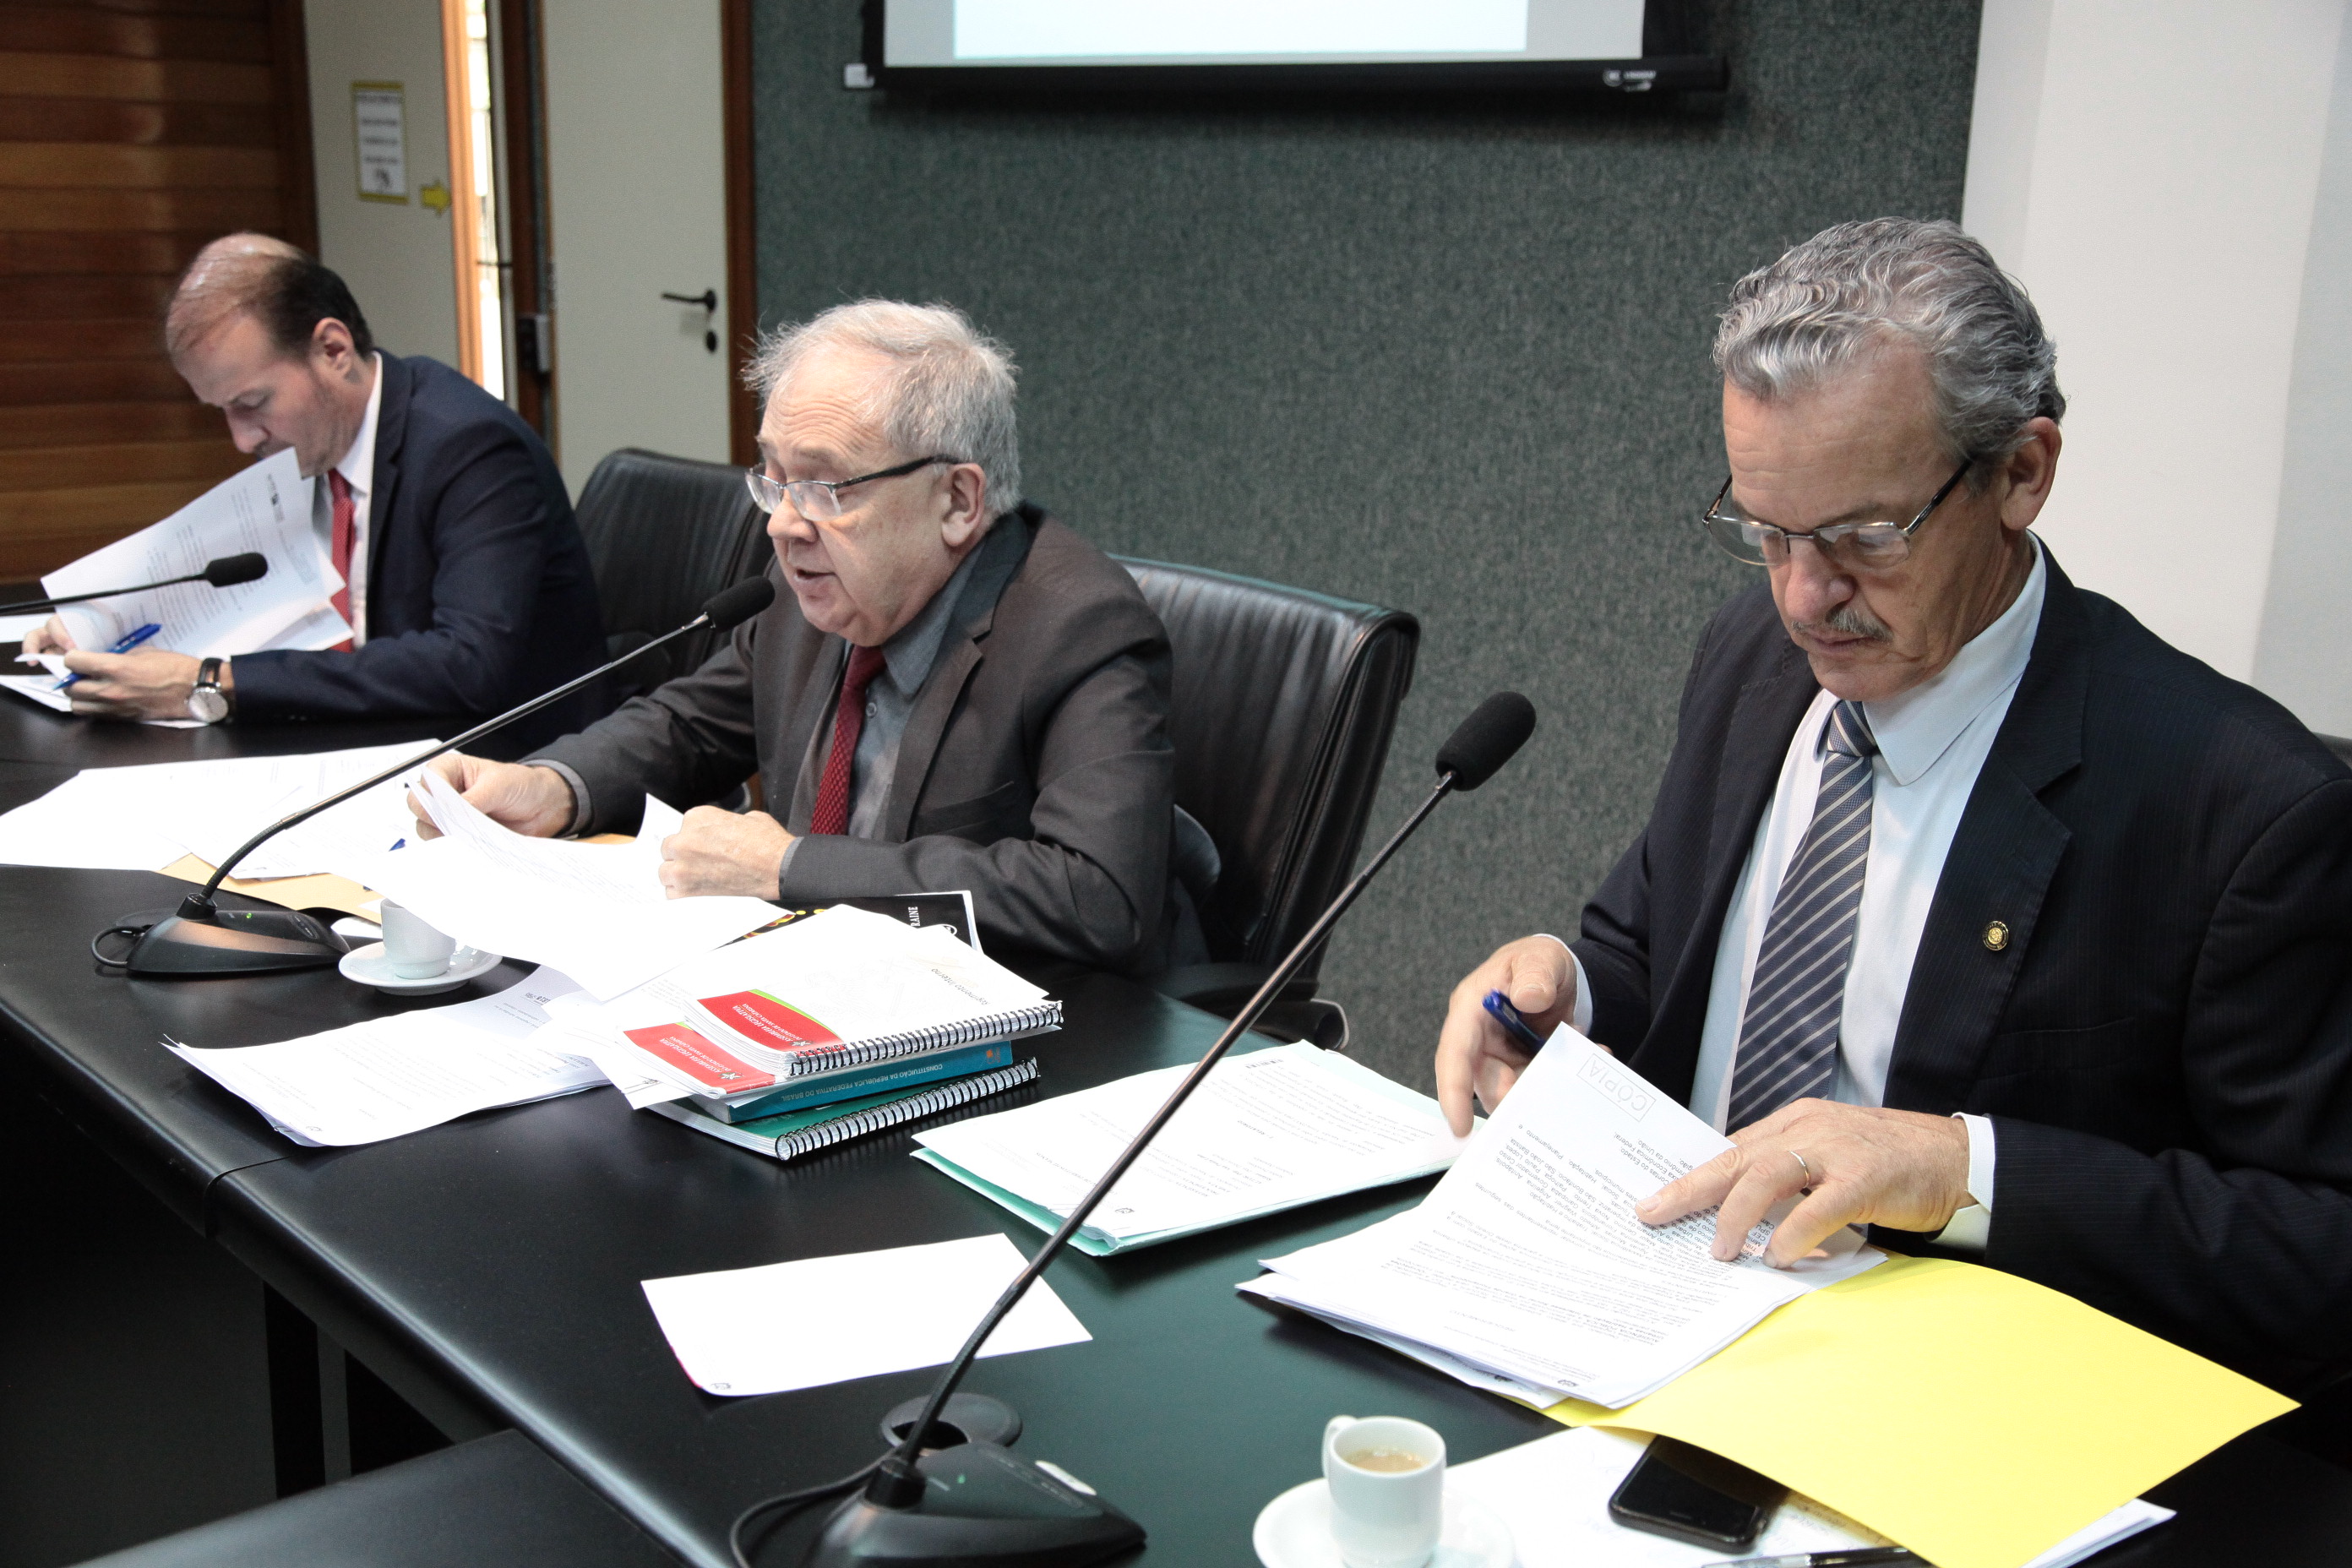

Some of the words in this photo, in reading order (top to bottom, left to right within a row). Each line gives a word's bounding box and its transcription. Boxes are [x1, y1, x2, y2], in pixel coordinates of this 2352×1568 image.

[898, 1063, 943, 1078] CONSTITUIÇÃO
[854, 1074, 888, 1087] REPÚBLICA
[1589, 1059, 1647, 1112] CÓPIA
[815, 1082, 852, 1094] FEDERATIVA
[781, 1092, 803, 1101] BRASIL
[1526, 1130, 1564, 1160] Planejamento
[1499, 1150, 1515, 1164] Celso
[1530, 1152, 1544, 1164] João
[1636, 1149, 1668, 1174] Econômica
[1524, 1158, 1541, 1173] Paulo
[1544, 1162, 1556, 1174] São
[1516, 1162, 1548, 1188] Governador
[1649, 1168, 1669, 1187] Contas
[1475, 1182, 1501, 1202] seguintes
[1584, 1192, 1597, 1202] São
[1594, 1208, 1609, 1221] Nova
[1563, 1214, 1587, 1232] Trabalho
[1579, 1216, 1600, 1230] Alfredo
[1636, 1225, 1658, 1239] Amaro
[1657, 1235, 1674, 1249] Santo
[1668, 1229, 1702, 1250] Municipais
